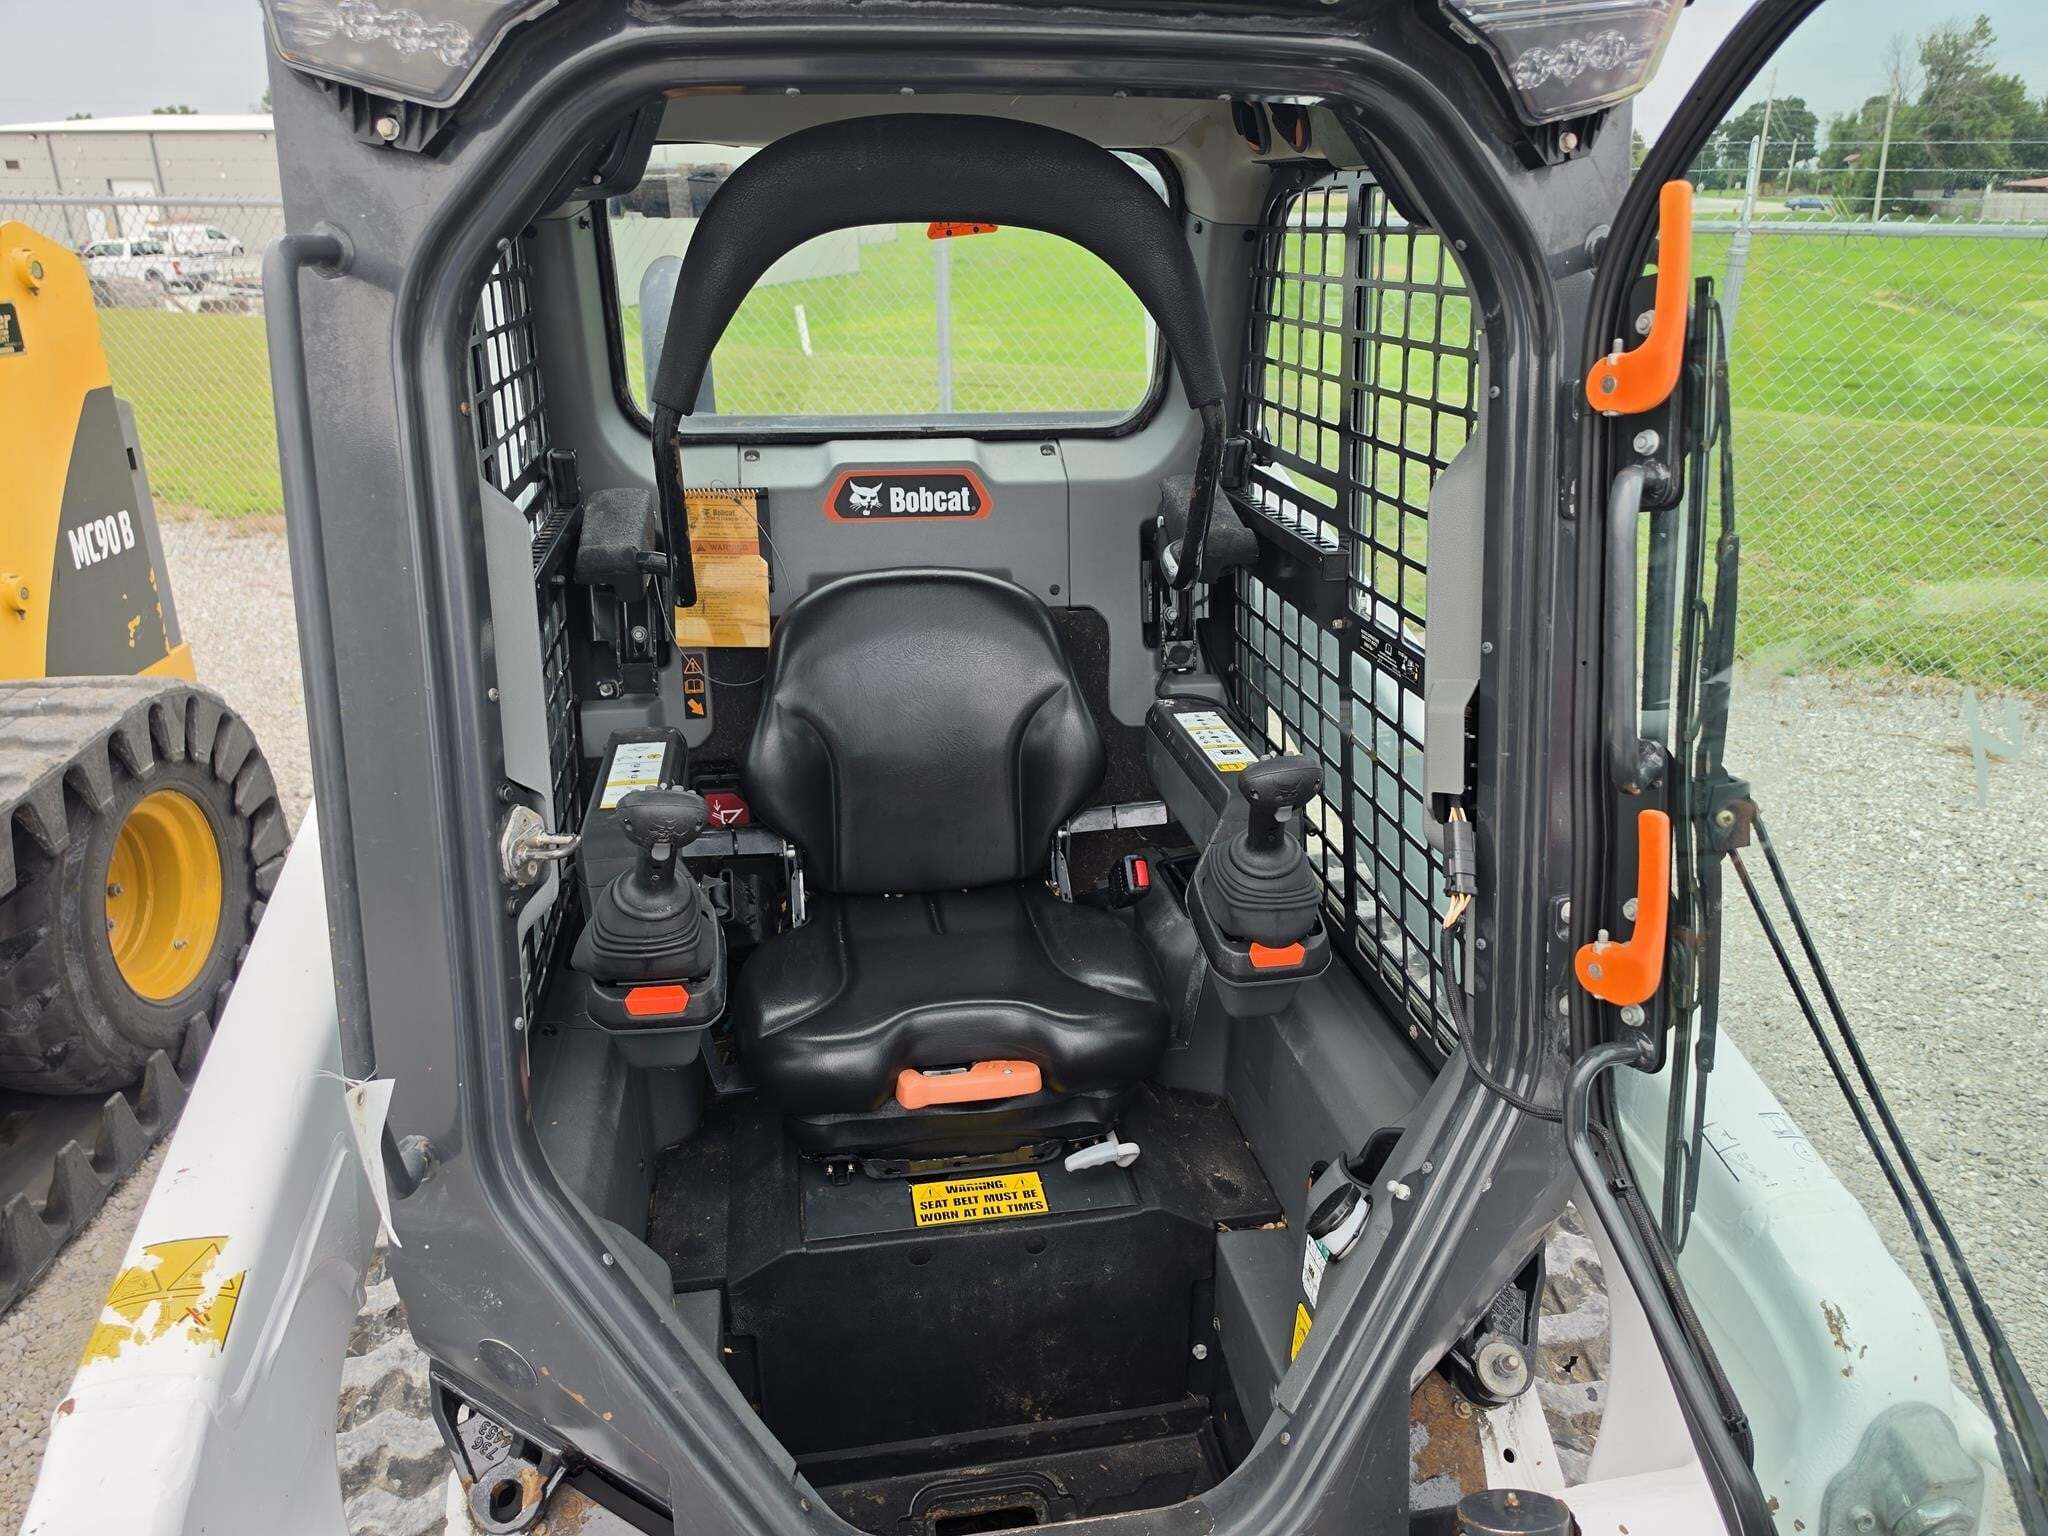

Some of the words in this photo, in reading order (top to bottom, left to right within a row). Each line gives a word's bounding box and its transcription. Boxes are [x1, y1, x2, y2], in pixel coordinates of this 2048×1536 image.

[889, 487, 970, 513] Bobcat
[68, 515, 121, 570] MC90
[118, 510, 135, 550] B
[920, 1199, 949, 1210] SEAT
[953, 1195, 979, 1206] BELT
[984, 1191, 1018, 1203] MUST
[1023, 1189, 1038, 1198] BE
[920, 1210, 959, 1222] WORN
[964, 1208, 977, 1217] AT
[983, 1205, 1003, 1215] ALL
[1007, 1201, 1044, 1212] TIMES
[471, 1436, 499, 1461] 736
